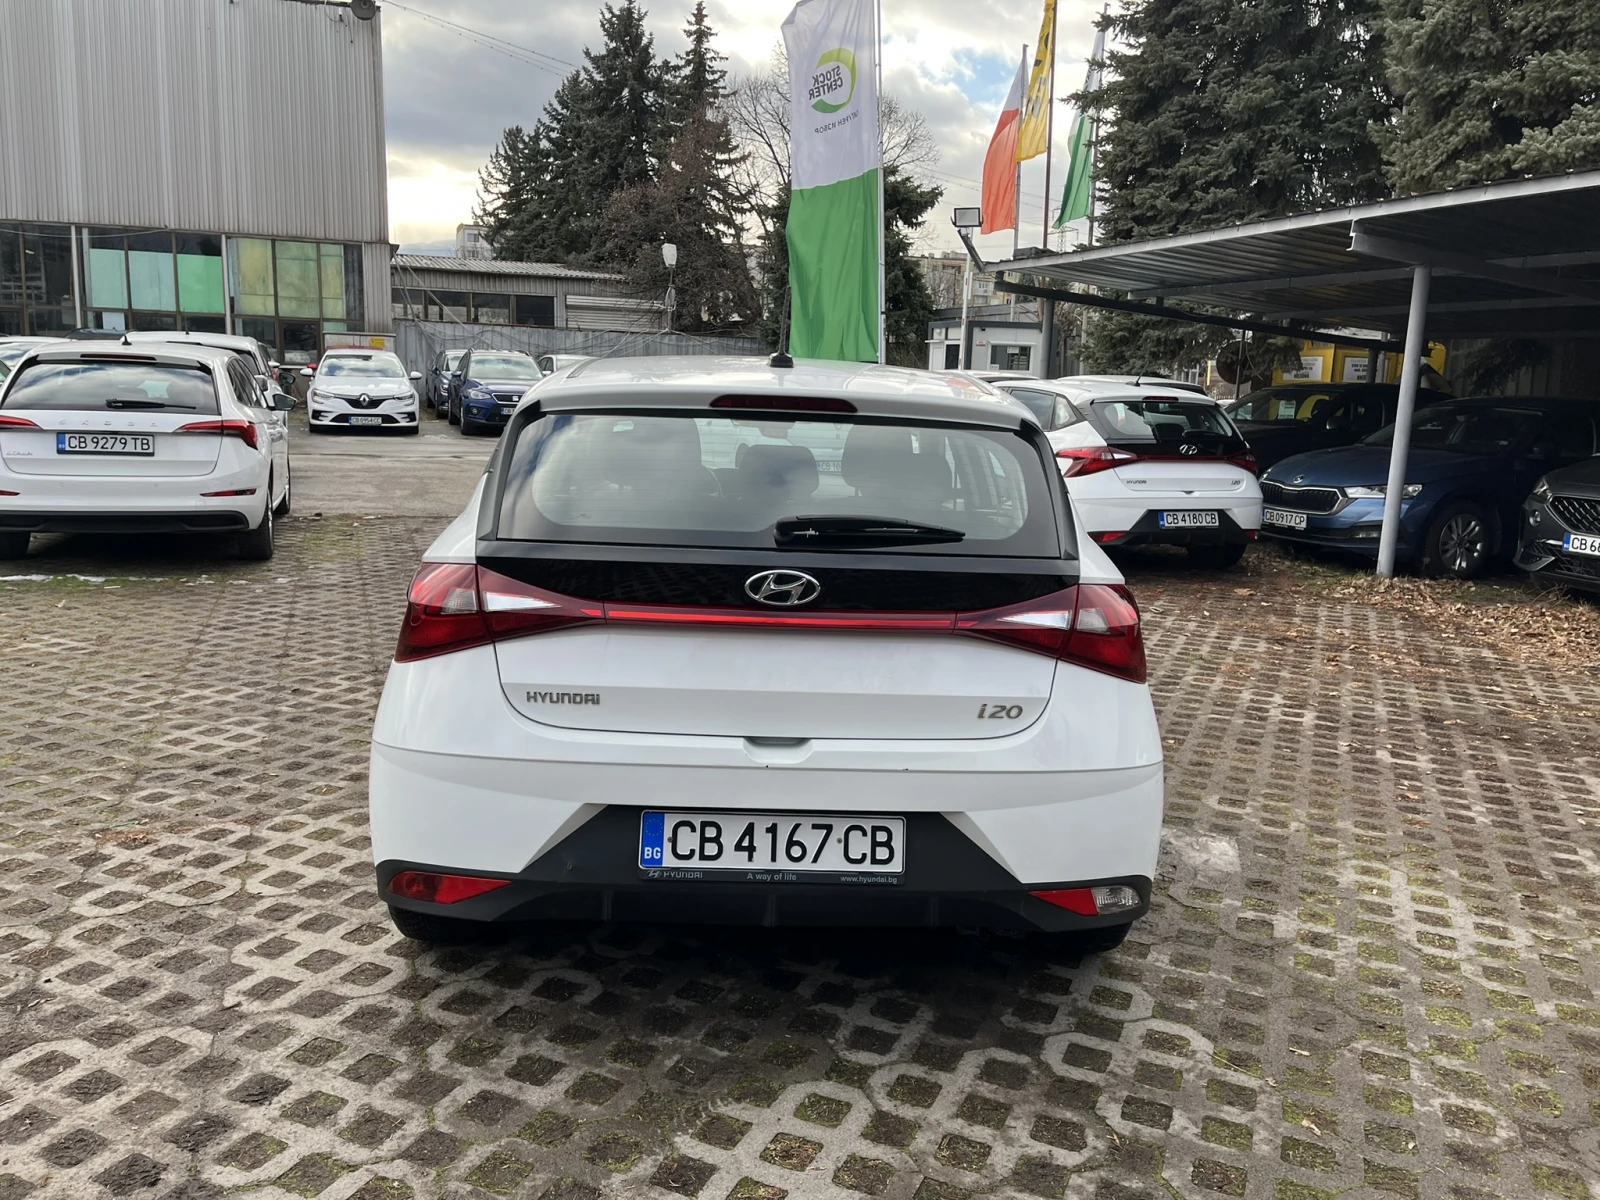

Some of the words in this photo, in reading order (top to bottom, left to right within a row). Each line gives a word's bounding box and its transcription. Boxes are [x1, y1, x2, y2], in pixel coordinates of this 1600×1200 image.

[67, 436, 88, 449] CB
[91, 436, 128, 450] 9279
[131, 437, 151, 451] TB
[821, 462, 831, 470] CB
[1165, 512, 1179, 524] CB
[1181, 512, 1204, 525] 4180
[1204, 512, 1217, 524] CB
[1265, 510, 1275, 522] CB
[1275, 511, 1294, 525] 0917
[1294, 514, 1305, 528] CP
[1572, 538, 1587, 550] CB
[526, 691, 600, 705] HYUNDAI
[977, 703, 1023, 719] i20
[644, 847, 661, 860] BG
[670, 820, 724, 861] CB
[734, 821, 834, 864] 4167
[843, 824, 895, 866] CB
[663, 871, 703, 879] HYUNDAI
[746, 872, 754, 880] A
[755, 873, 771, 882] way
[774, 873, 783, 881] of
[784, 873, 797, 881] life
[840, 875, 898, 884] www.hyundai.bg
